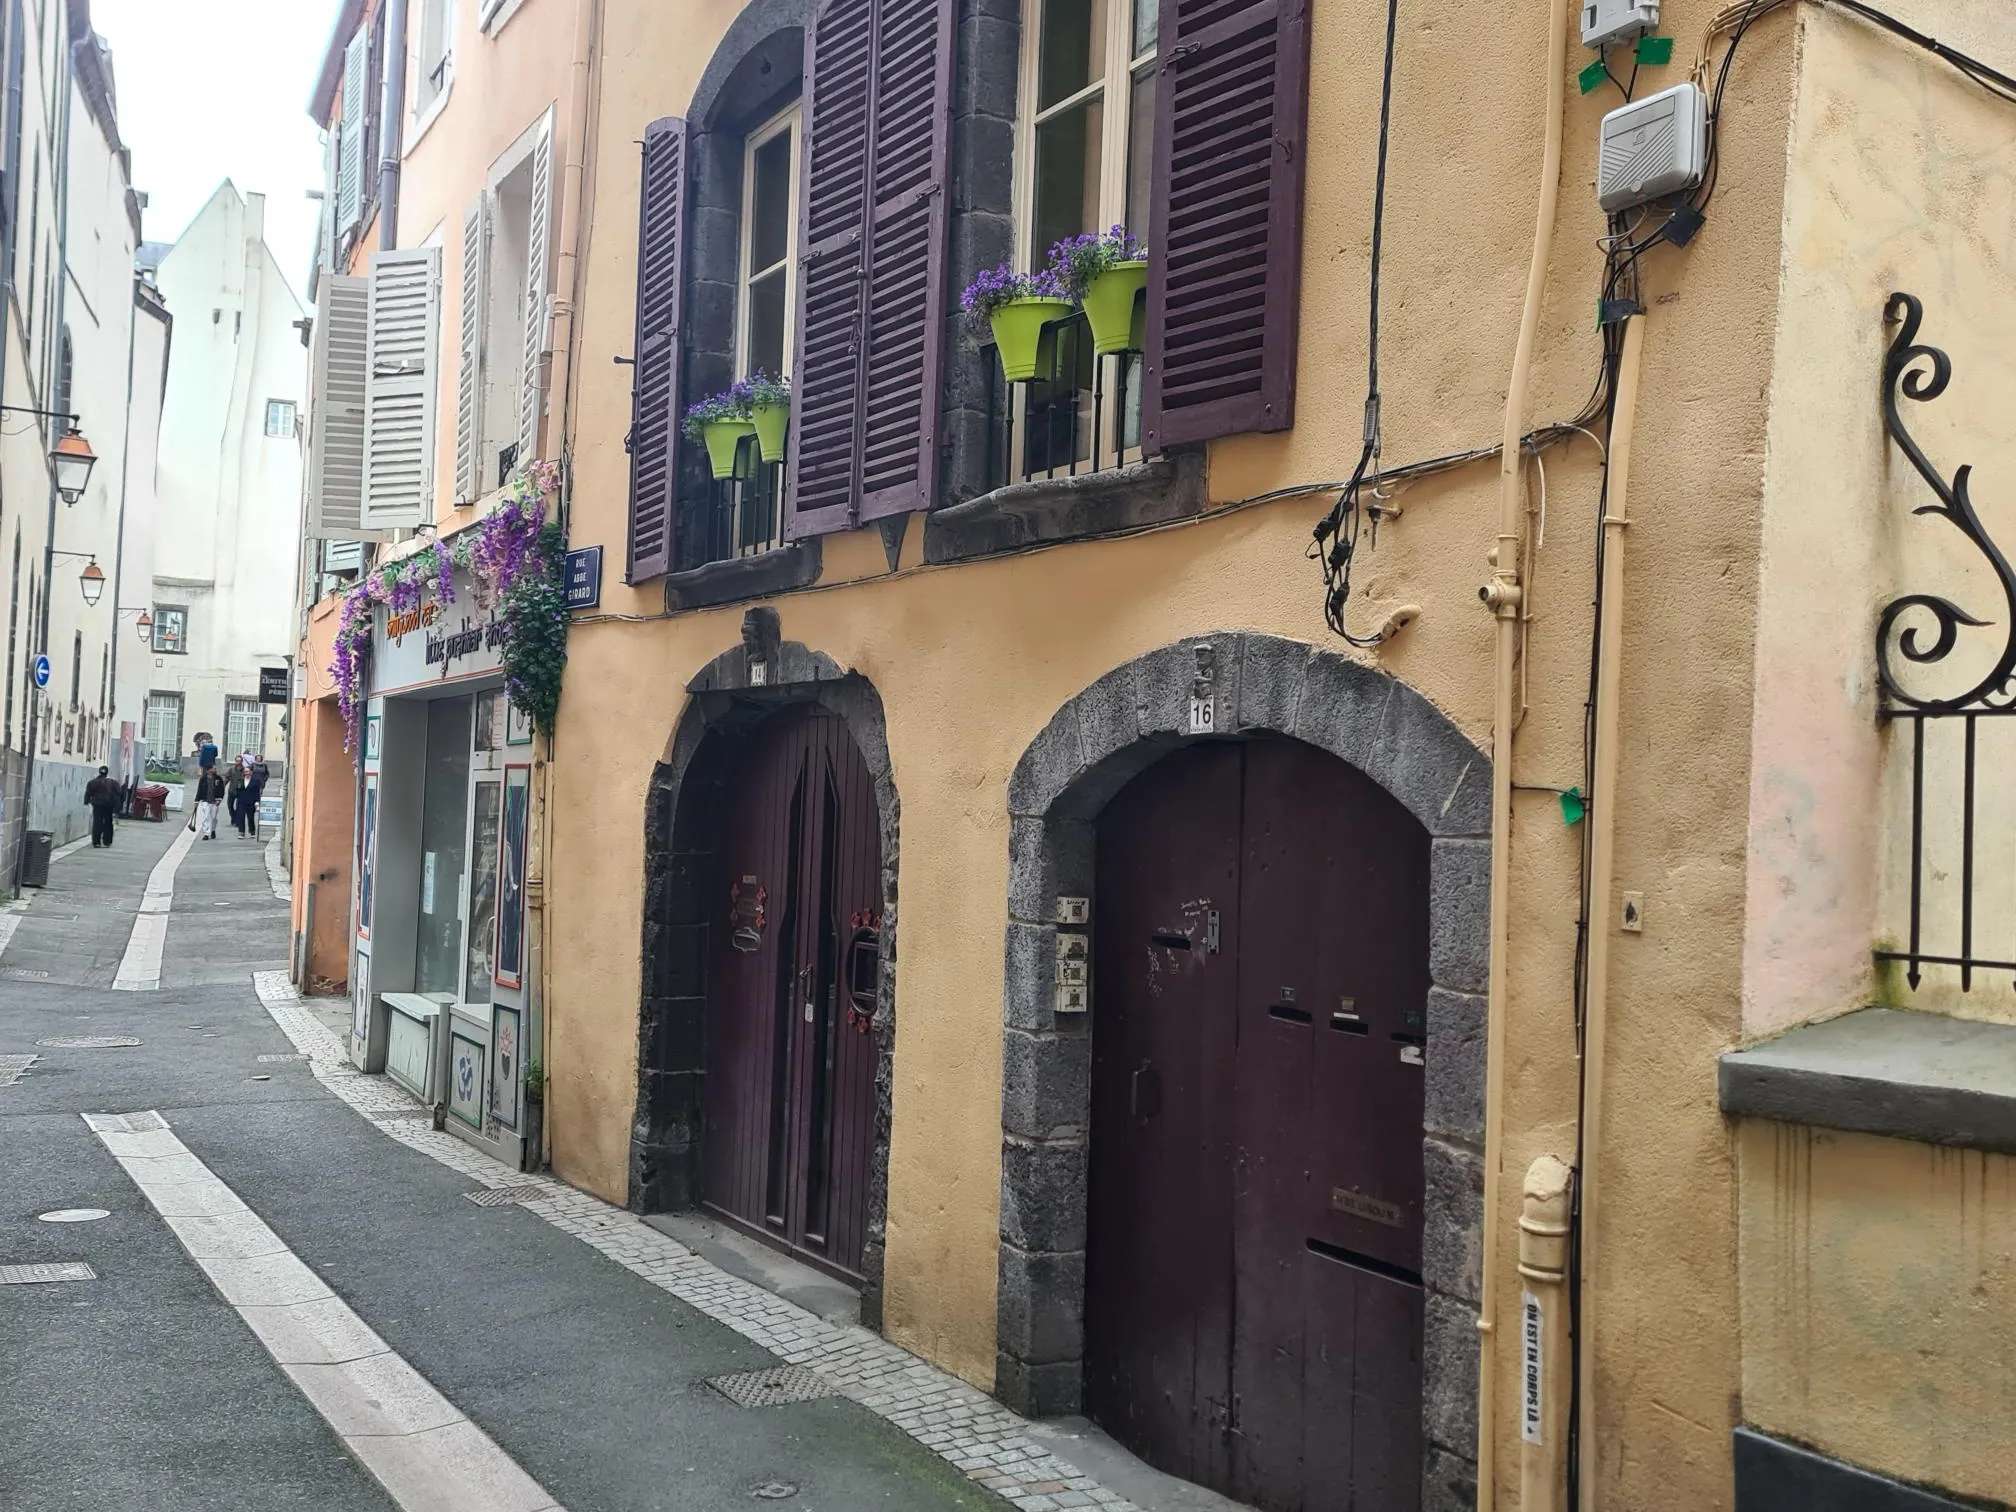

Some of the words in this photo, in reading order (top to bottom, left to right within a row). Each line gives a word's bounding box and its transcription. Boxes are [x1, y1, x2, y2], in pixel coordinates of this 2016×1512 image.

[575, 558, 586, 568] RUE
[567, 586, 591, 601] GIRARD
[444, 616, 482, 673] pushkar
[1193, 703, 1212, 726] 16
[1527, 1303, 1538, 1320] ON
[1527, 1323, 1538, 1347] EST
[1527, 1347, 1538, 1364] EN
[1527, 1364, 1538, 1406] CORPS
